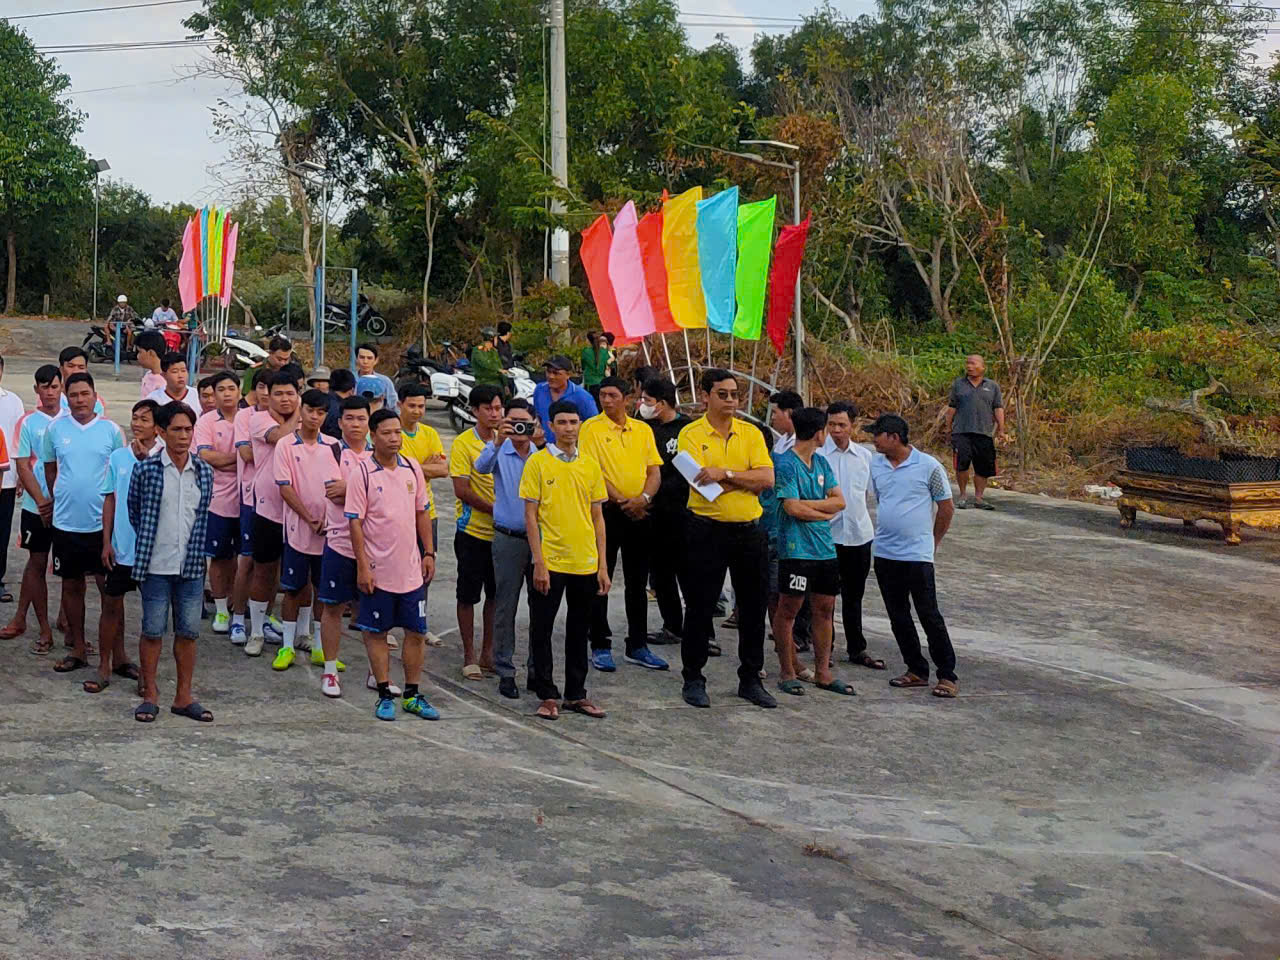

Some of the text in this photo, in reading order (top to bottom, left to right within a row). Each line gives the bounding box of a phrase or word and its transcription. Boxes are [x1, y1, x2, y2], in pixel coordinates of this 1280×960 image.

[24, 530, 32, 544] 7
[54, 557, 61, 571] 9
[789, 574, 808, 591] 209
